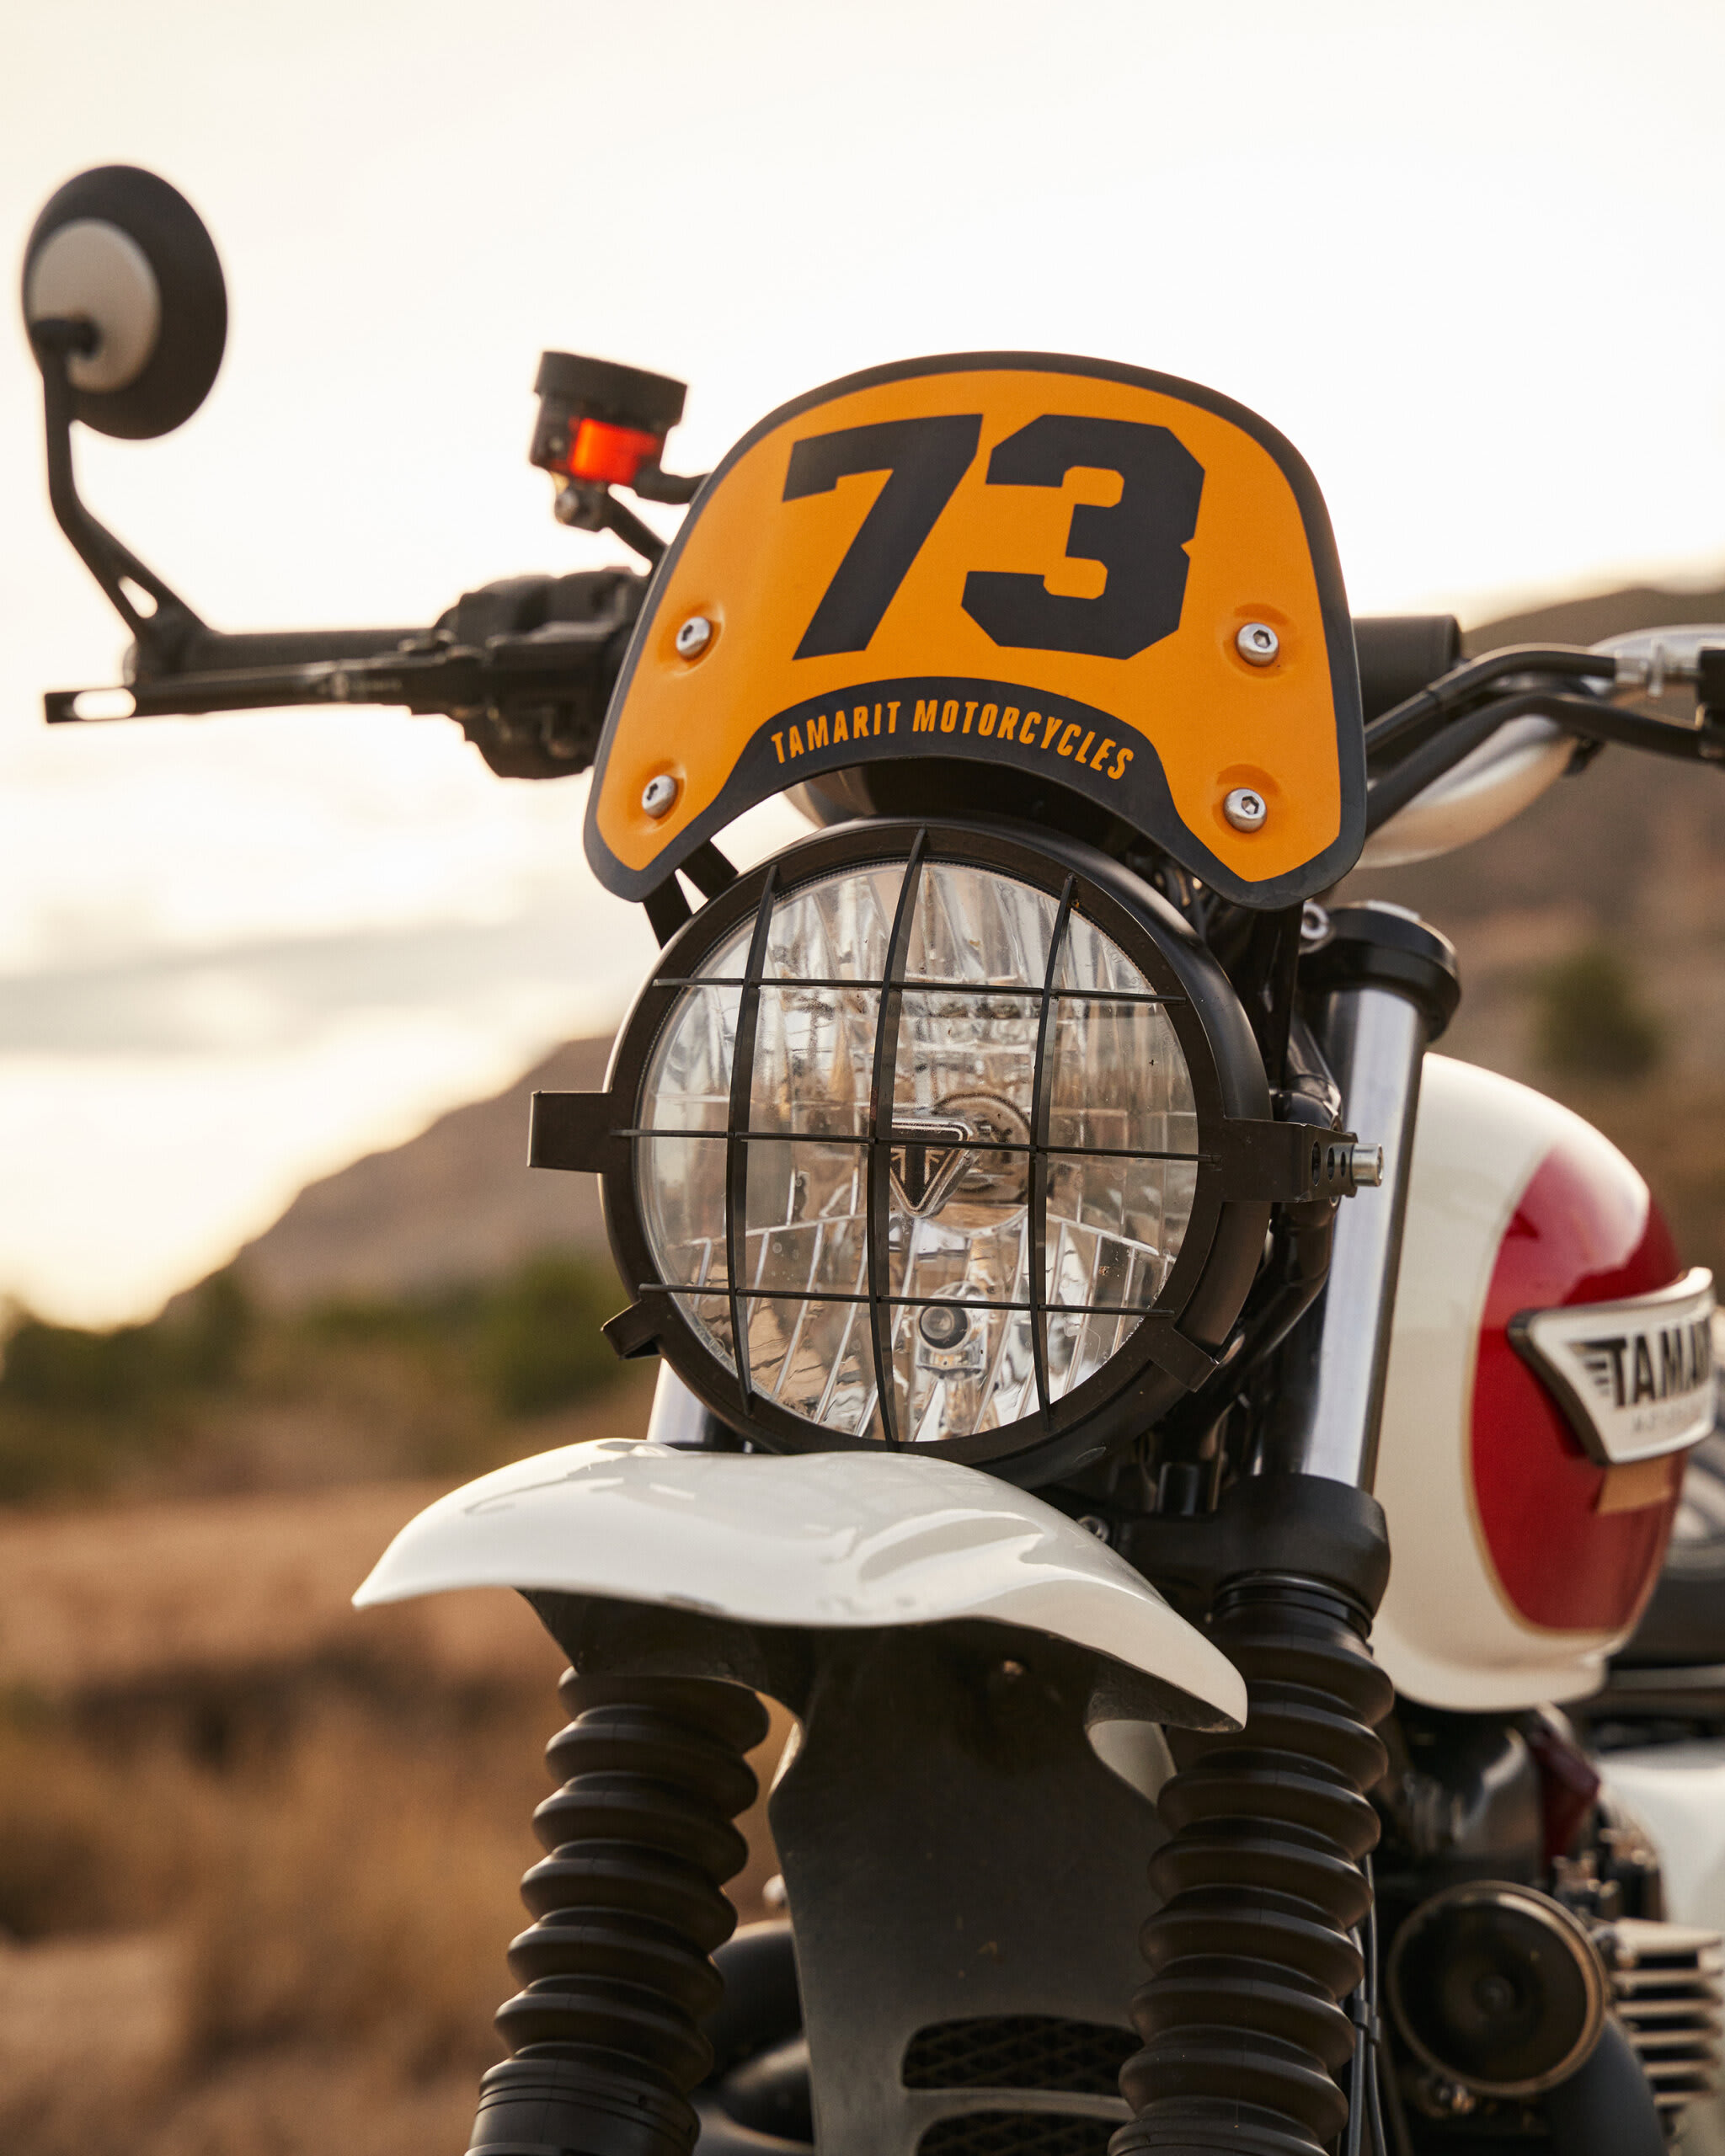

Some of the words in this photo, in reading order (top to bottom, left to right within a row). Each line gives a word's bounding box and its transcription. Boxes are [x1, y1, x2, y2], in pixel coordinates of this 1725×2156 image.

[783, 414, 1204, 660] 73
[771, 701, 901, 764] TAMARIT
[912, 699, 1135, 780] MOTORCYCLES
